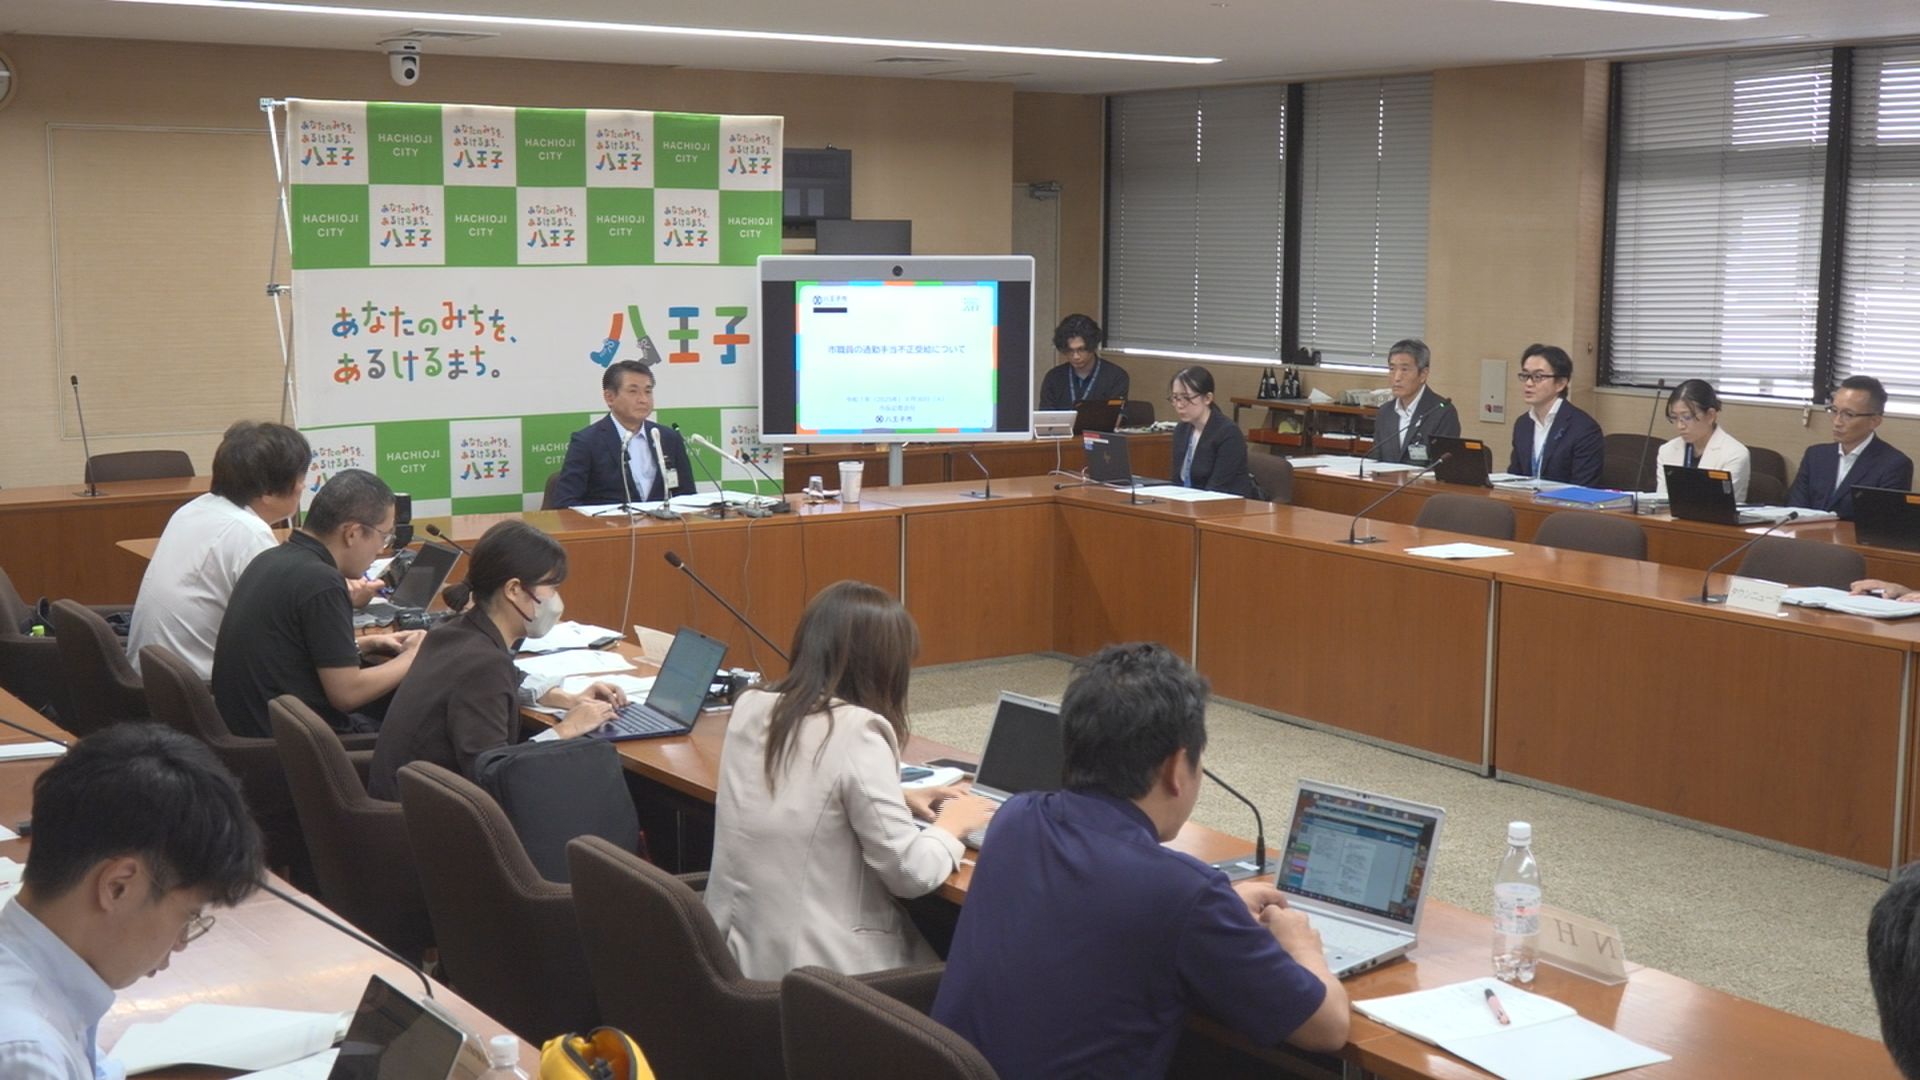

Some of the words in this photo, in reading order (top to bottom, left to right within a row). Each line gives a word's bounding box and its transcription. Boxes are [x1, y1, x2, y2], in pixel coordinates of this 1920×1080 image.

[301, 134, 351, 143] あるけるまち。
[378, 133, 432, 144] HACHIOJI
[453, 137, 500, 147] あるけるまち。
[525, 138, 575, 147] HACHIOJI
[596, 141, 640, 150] あるけるまち。
[663, 142, 710, 151] HACHIOJI
[729, 145, 769, 154] あるけるまち。
[301, 146, 355, 166] 八王子
[392, 148, 418, 157] CITY
[538, 152, 562, 161] CITY
[453, 149, 504, 168] 八王子
[595, 153, 643, 170] 八王子
[727, 157, 772, 174] 八王子
[303, 214, 358, 223] HACHIOJI
[381, 216, 429, 226] あるけるまち。
[455, 214, 507, 224] HACHIOJI
[527, 217, 572, 226] あるけるまち。
[596, 215, 645, 224] HACHIOJI
[664, 218, 705, 227] あるけるまち。
[728, 217, 773, 226] HACHIOJI
[317, 228, 344, 237] CITY
[468, 228, 493, 237] CITY
[608, 228, 633, 236] CITY
[739, 230, 761, 238] CITY
[379, 229, 433, 247] 八王子
[527, 229, 576, 247] 八王子
[663, 229, 709, 247] 八王子
[332, 300, 517, 344] あなたのみちを、
[590, 305, 750, 368] 八王子
[334, 345, 500, 384] あるけるまち。
[531, 442, 569, 453] HACHI
[386, 450, 440, 461] HACHIOJI
[461, 449, 507, 459] あるけるまち。
[310, 457, 360, 471] あるけるまち。
[544, 455, 566, 465] CIT
[400, 464, 426, 474] CITY
[460, 461, 510, 480] 八王子
